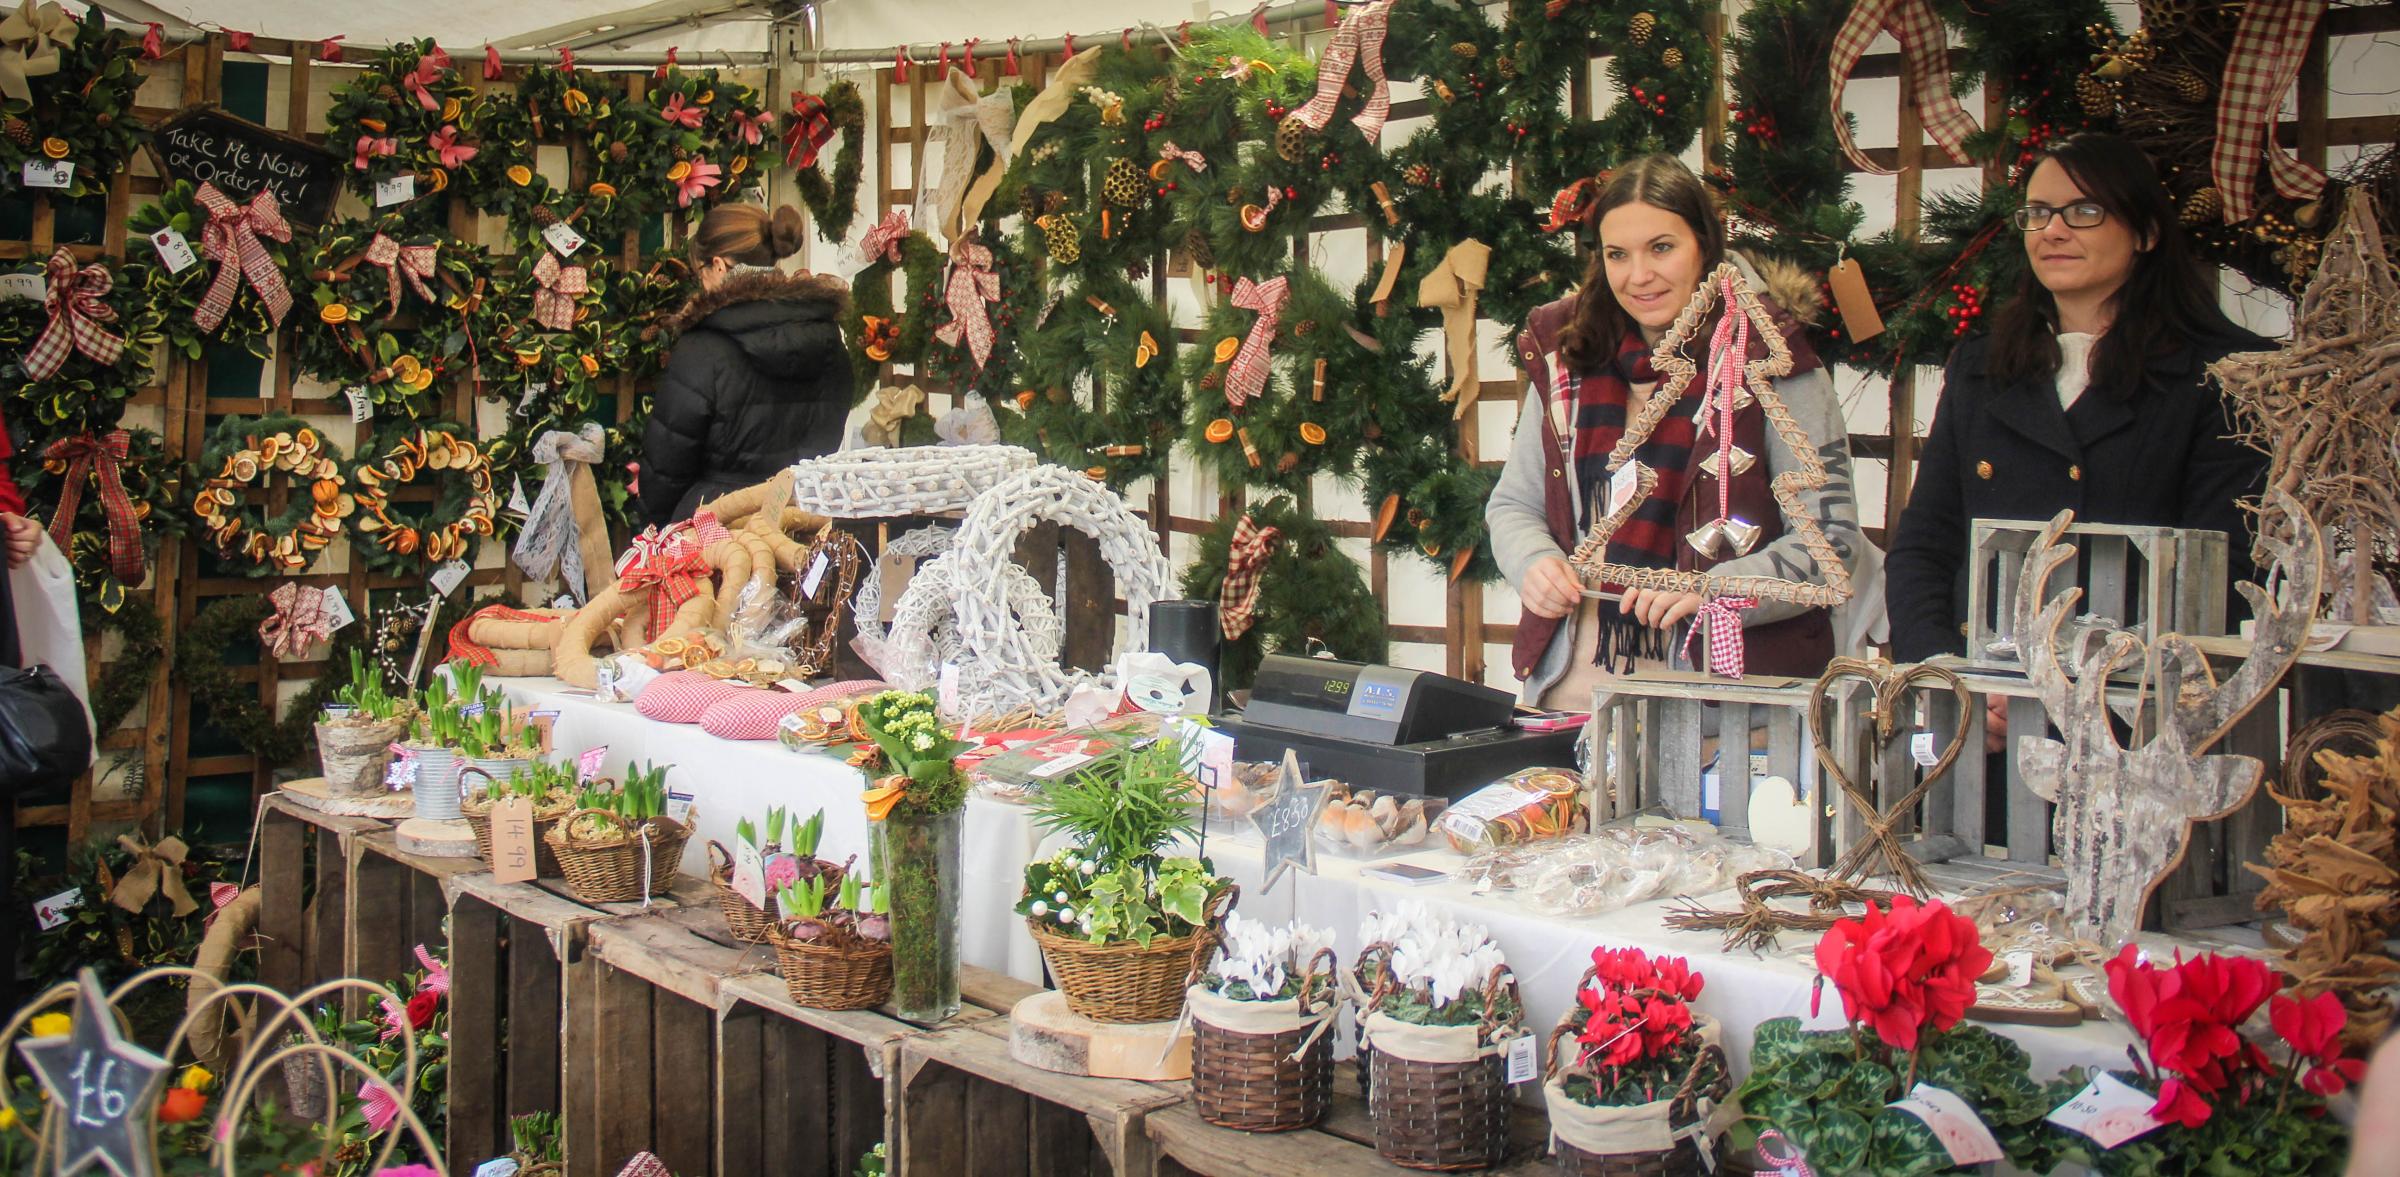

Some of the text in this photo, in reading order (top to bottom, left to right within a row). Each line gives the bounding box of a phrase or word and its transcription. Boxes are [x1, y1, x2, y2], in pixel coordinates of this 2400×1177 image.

[166, 128, 309, 178] Take Me Now
[194, 161, 260, 191] Order
[262, 178, 308, 205] Me!
[69, 1049, 126, 1128] £6
